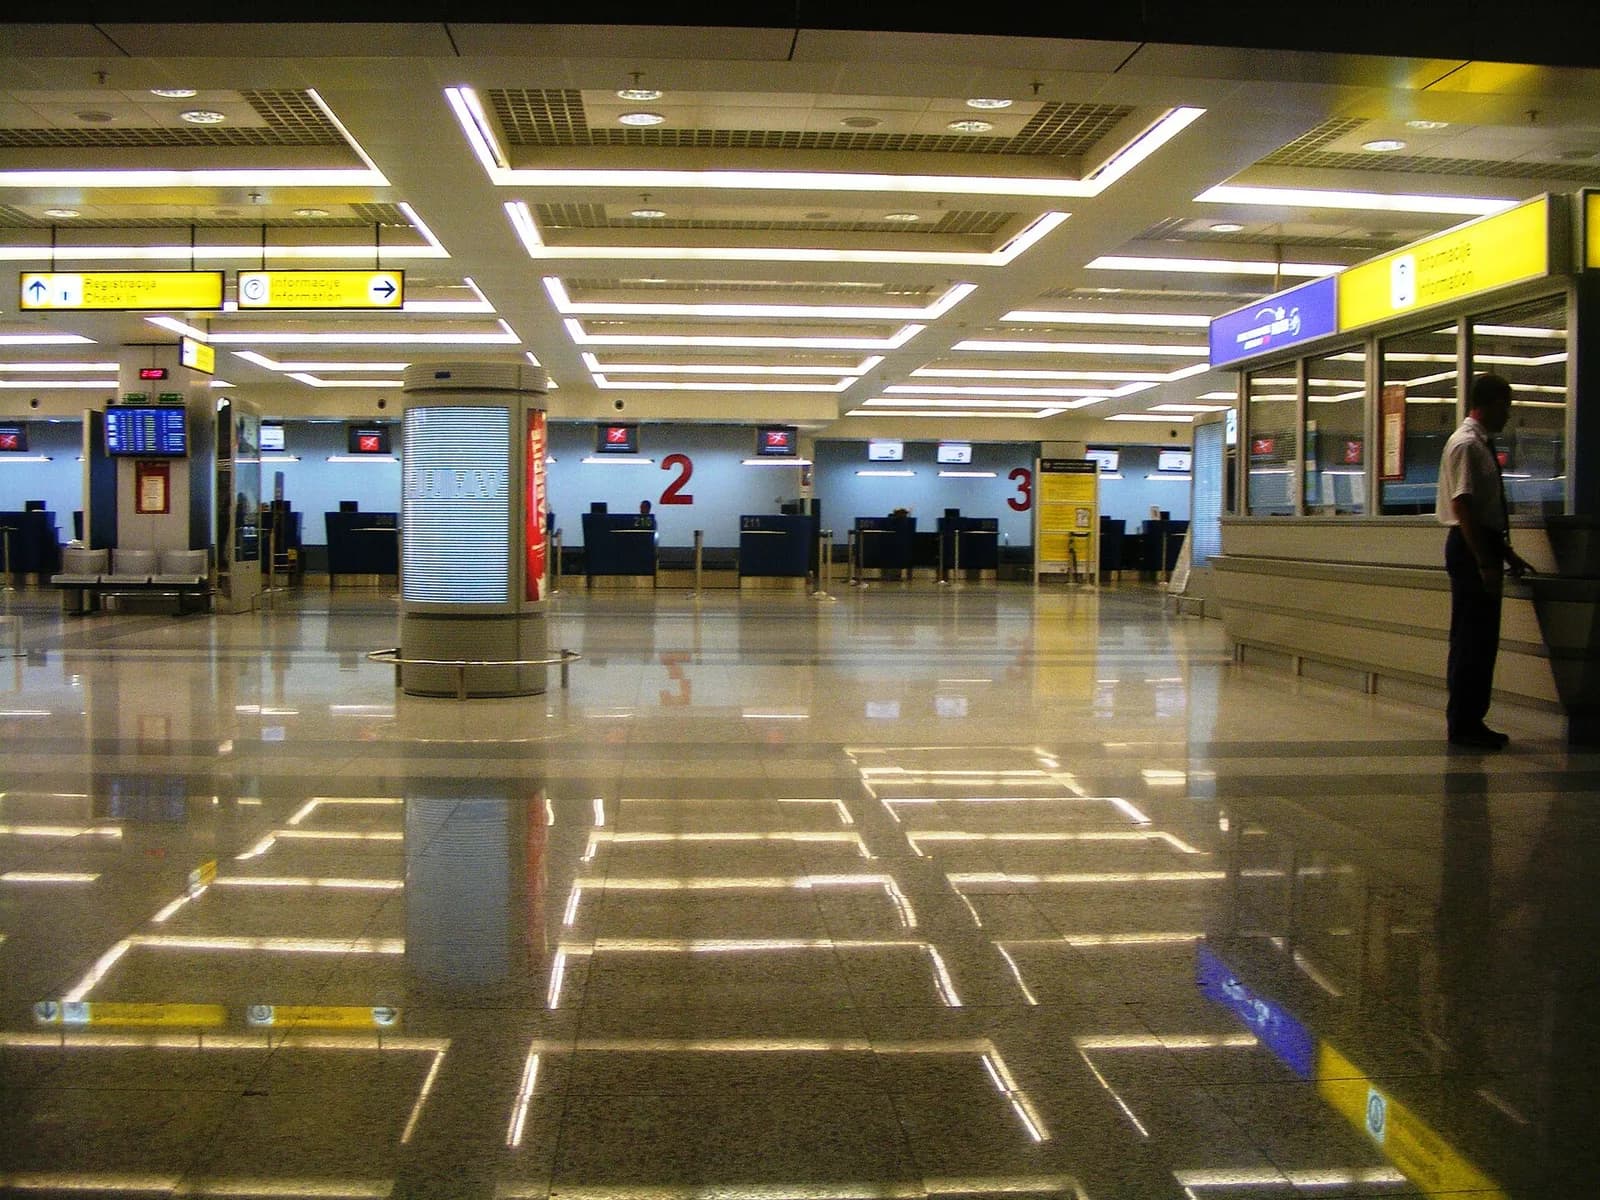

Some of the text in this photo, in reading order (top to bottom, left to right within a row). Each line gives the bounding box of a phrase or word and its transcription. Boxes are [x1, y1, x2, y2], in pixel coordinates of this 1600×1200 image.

[271, 276, 341, 290] Informacije
[271, 291, 342, 303] Information
[659, 453, 694, 505] 2
[1007, 467, 1032, 512] 3
